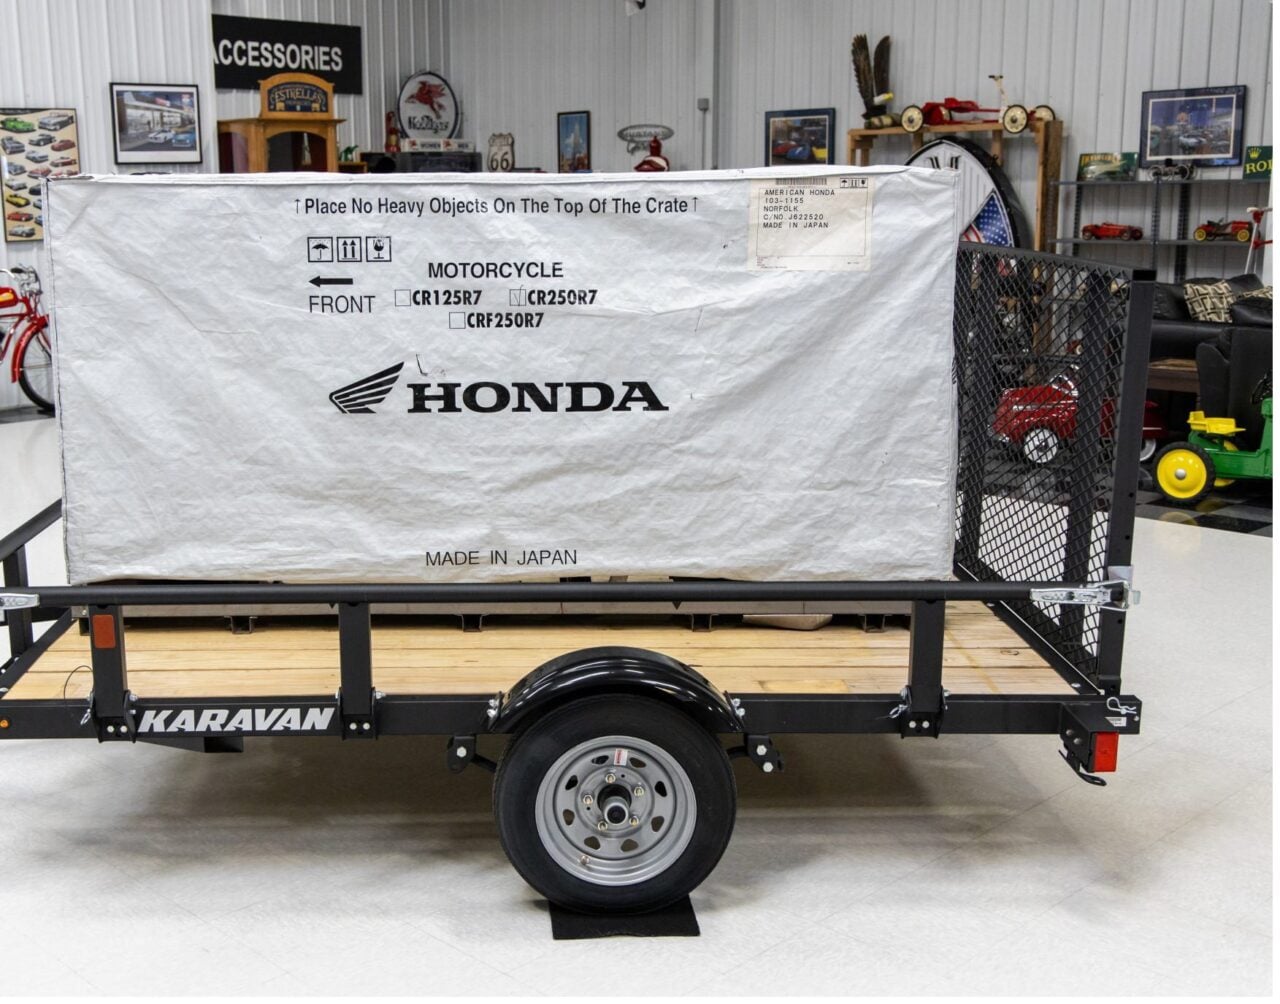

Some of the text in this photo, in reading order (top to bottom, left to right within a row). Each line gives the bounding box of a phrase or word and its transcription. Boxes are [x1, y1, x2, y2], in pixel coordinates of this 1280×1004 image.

[490, 152, 510, 171] 66
[305, 197, 688, 217] Place No Heavy Objects On The Top Of The Crate
[428, 262, 564, 278] MOTORCYCLE
[309, 295, 376, 313] FRONT
[412, 289, 598, 306] CR125R7 CR250R7
[466, 312, 545, 329] CRF250R7
[406, 381, 669, 413] HONDA
[425, 549, 577, 566] MADE IN JAPAN
[137, 707, 335, 732] KARAVAN
